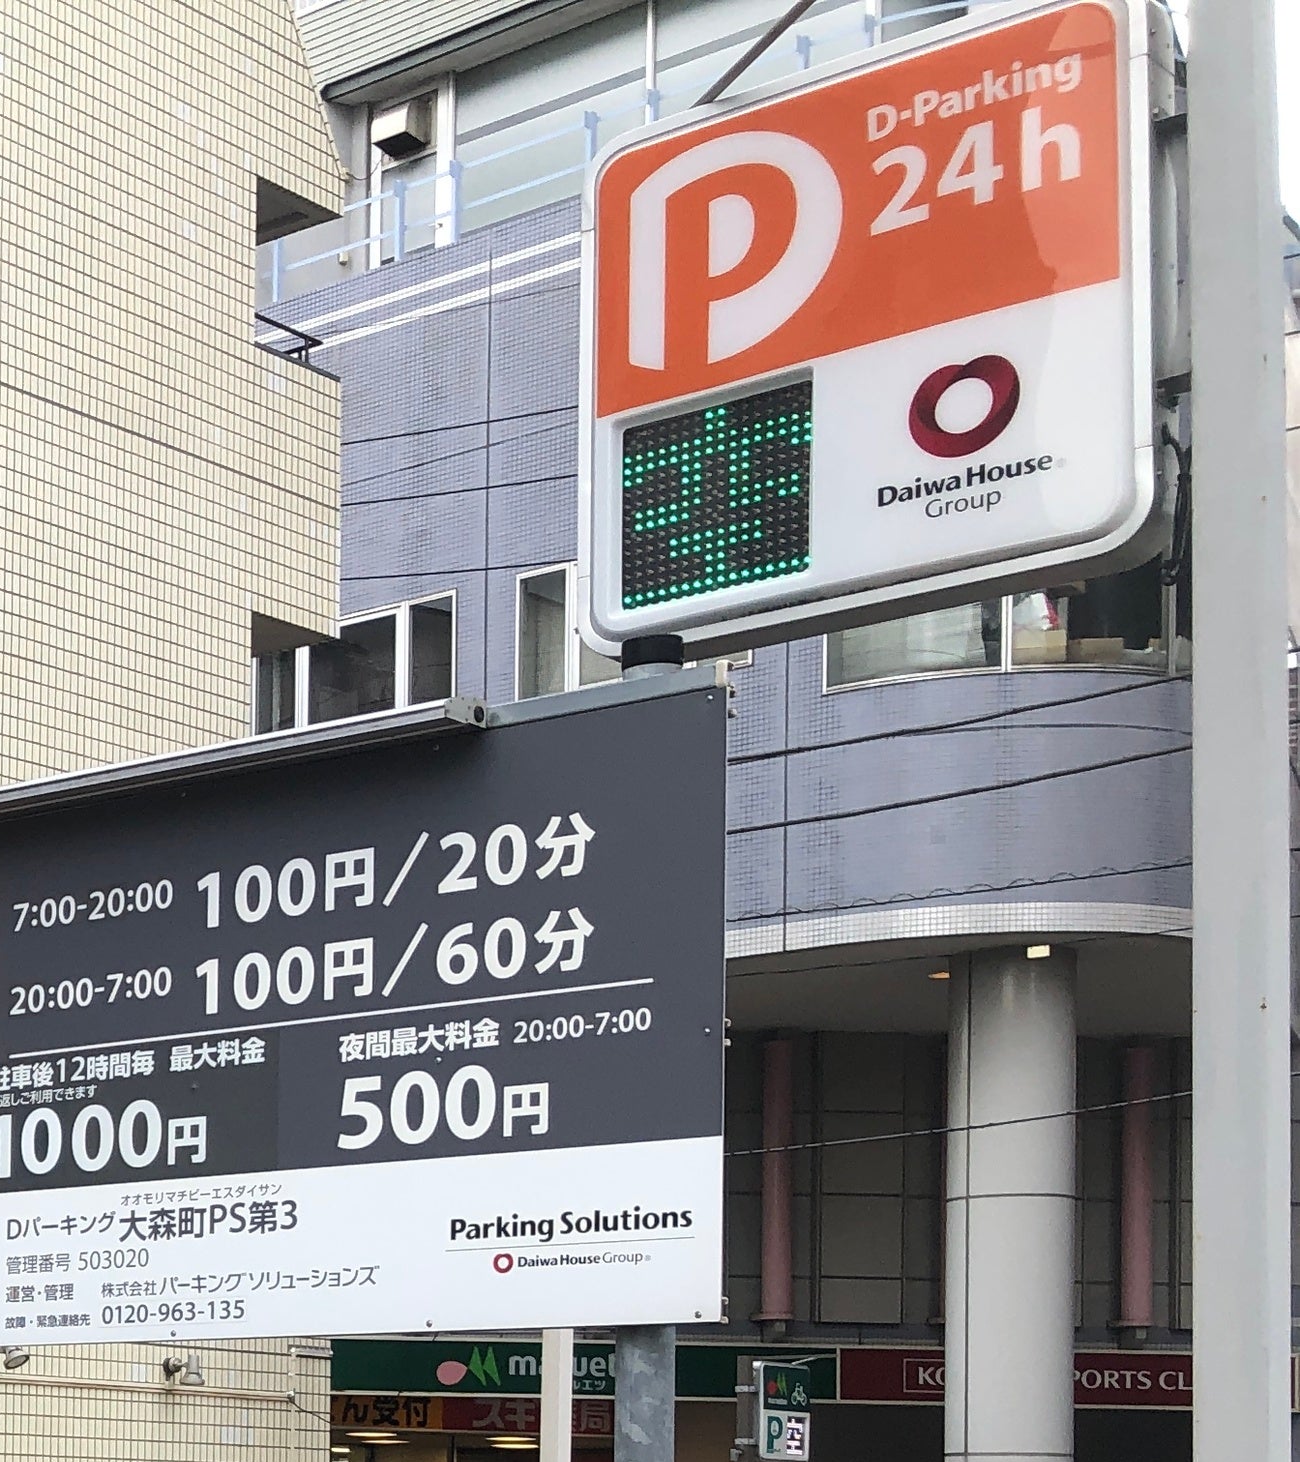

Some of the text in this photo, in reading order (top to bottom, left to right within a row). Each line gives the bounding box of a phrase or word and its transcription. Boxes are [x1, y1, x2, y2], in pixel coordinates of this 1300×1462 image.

[866, 52, 1083, 143] D-Parking
[870, 106, 1082, 237] 24h
[877, 451, 1054, 509] Daiwa House
[923, 486, 1002, 520] Group
[13, 880, 174, 933] 7:00-20:00
[9, 966, 172, 1015] 20:00-7:00
[338, 1007, 653, 1064] 夜間最大料金 20:00-7:00
[169, 1036, 266, 1073] 最大料金
[337, 1063, 551, 1152] 500円
[450, 1205, 693, 1242] Parking Solutions
[5, 1248, 150, 1275] 管理番号 503020
[517, 1251, 643, 1268] Daiwa House Group
[5, 1283, 74, 1303] 運営・管理
[5, 1299, 245, 1330] 故障・緊急連絡先 0120-963-135
[341, 1396, 431, 1427] ん受付
